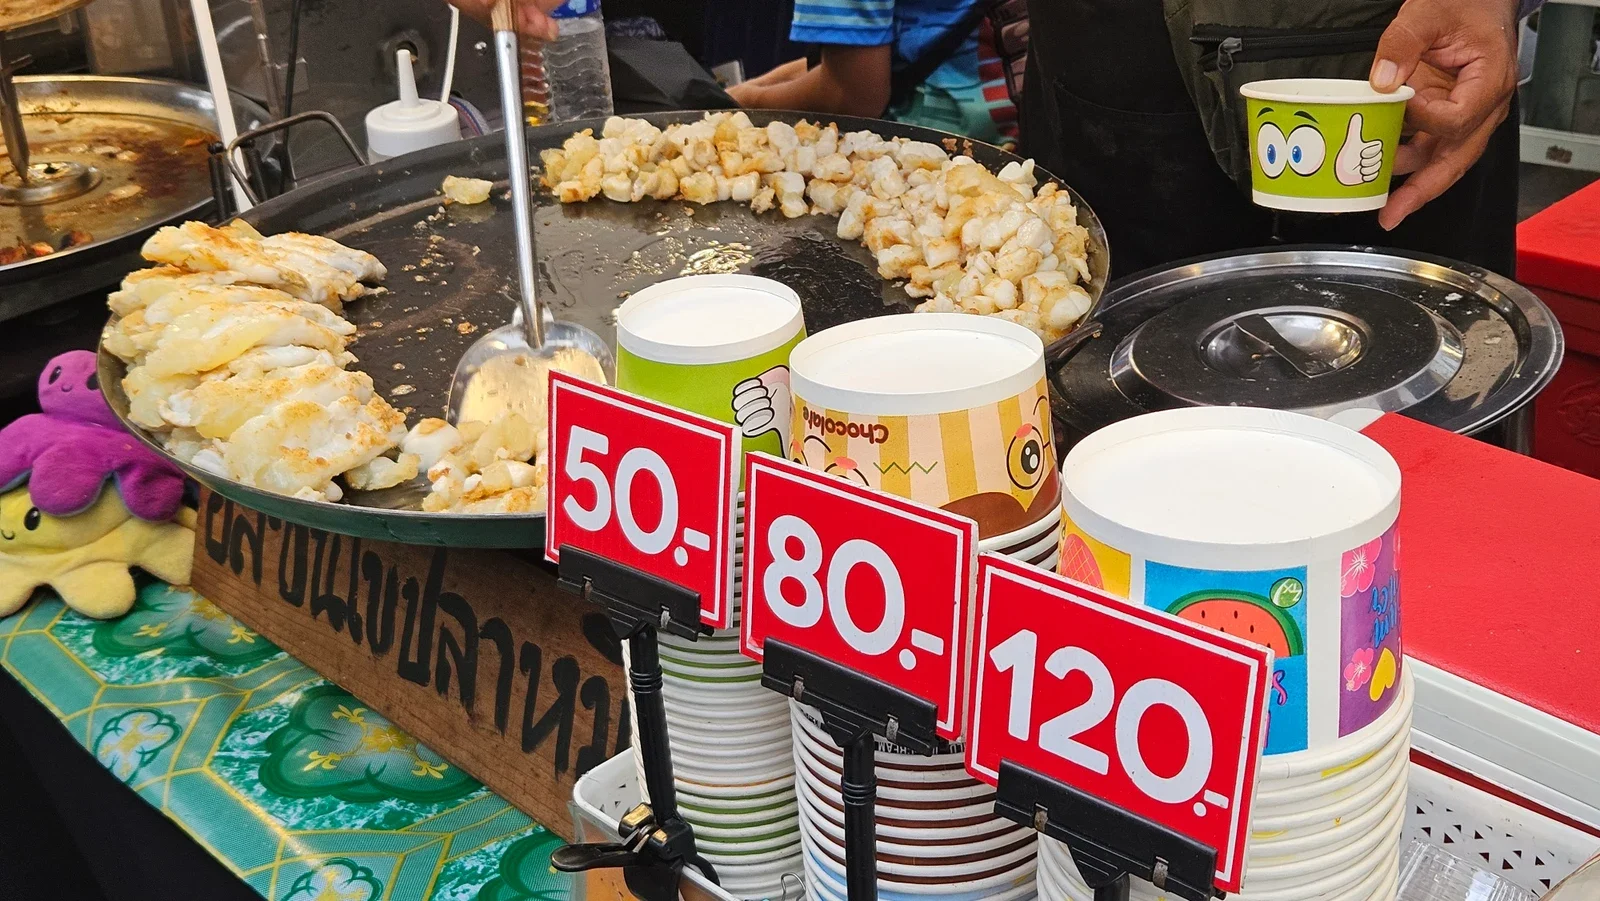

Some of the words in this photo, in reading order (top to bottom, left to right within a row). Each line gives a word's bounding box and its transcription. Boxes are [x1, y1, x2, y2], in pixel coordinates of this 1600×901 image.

[563, 424, 711, 567] 50.-
[802, 405, 889, 444] Chocolate
[763, 514, 945, 671] 80.-
[989, 628, 1230, 817] 120.-
